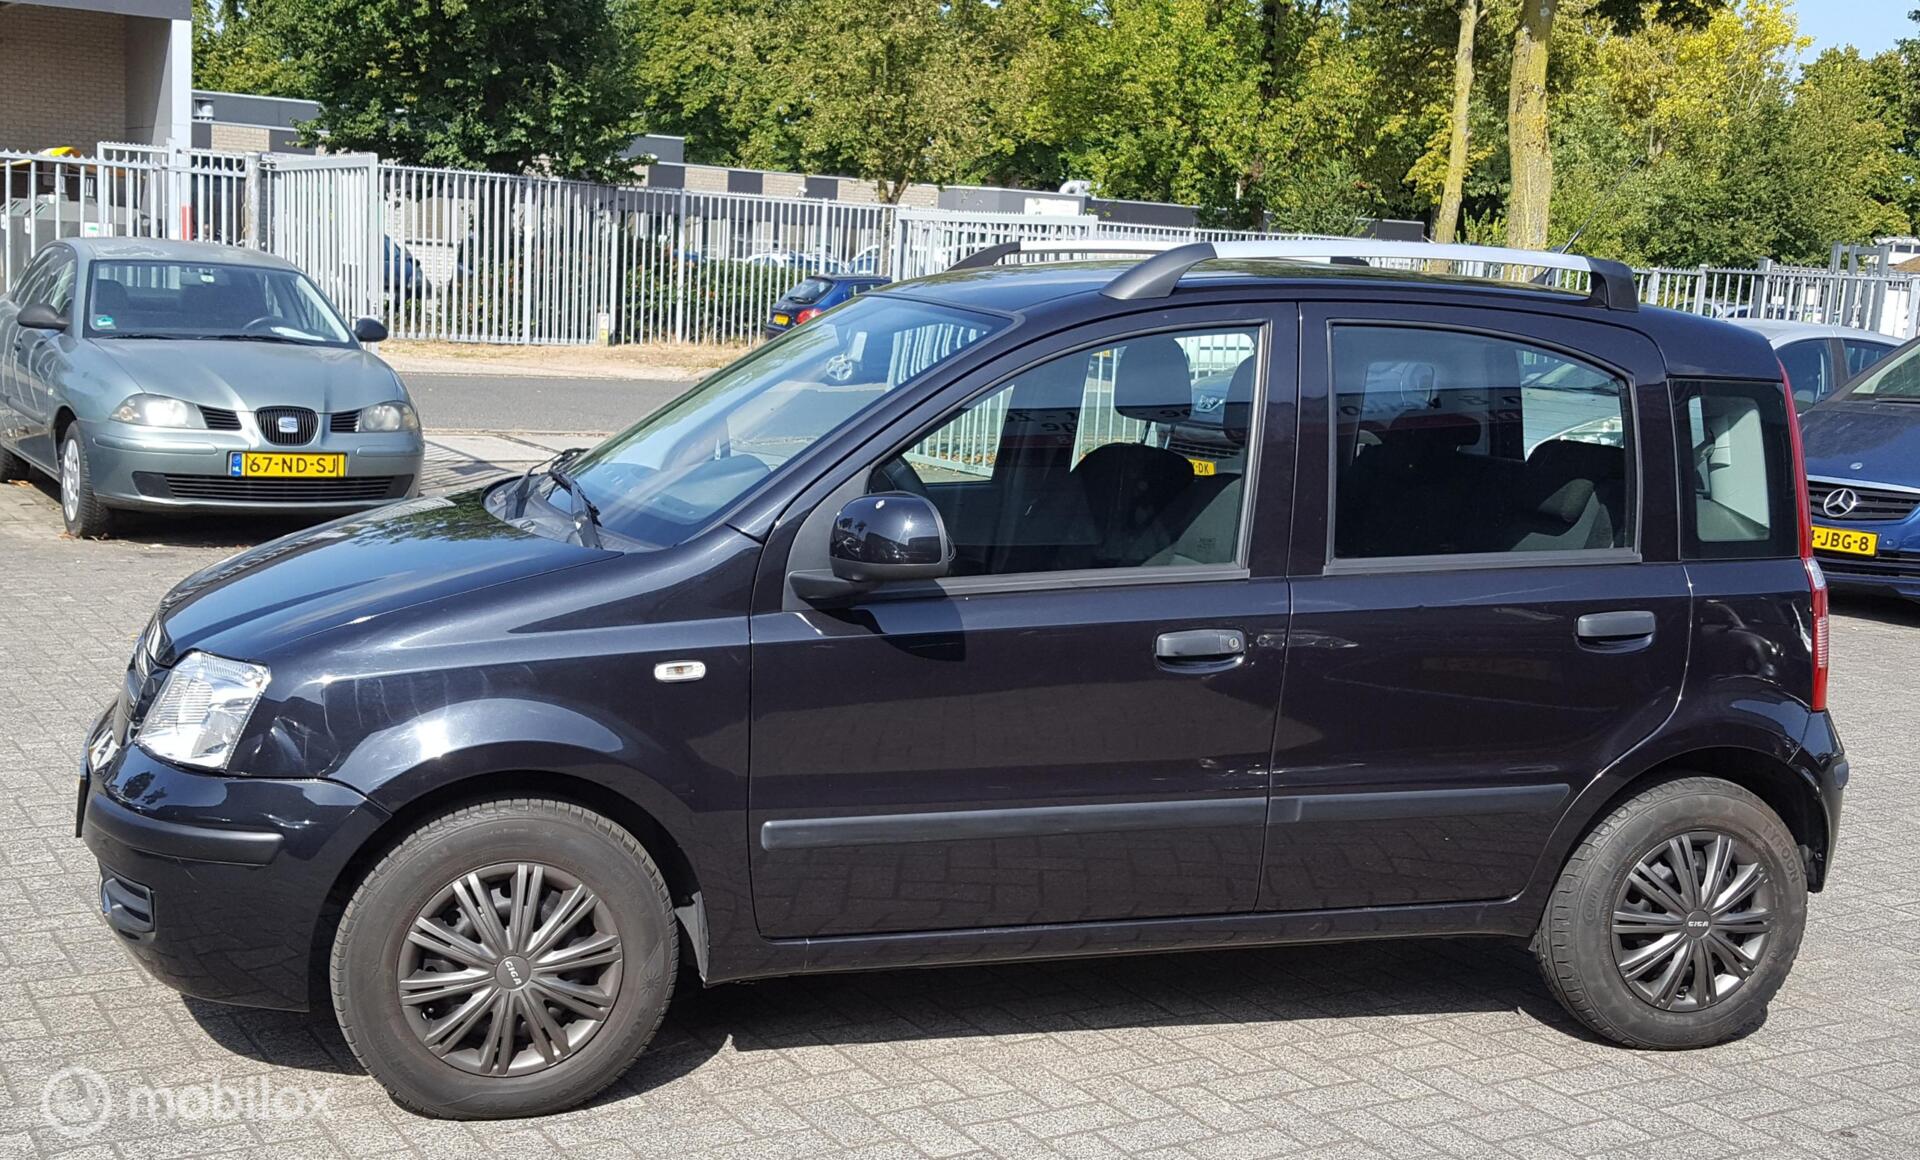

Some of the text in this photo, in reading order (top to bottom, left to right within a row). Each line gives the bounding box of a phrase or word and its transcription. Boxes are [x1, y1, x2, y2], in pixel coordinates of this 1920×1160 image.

[249, 456, 337, 474] 67-ND-SJ
[1194, 462, 1210, 474] -DK
[504, 960, 523, 986] GIGA
